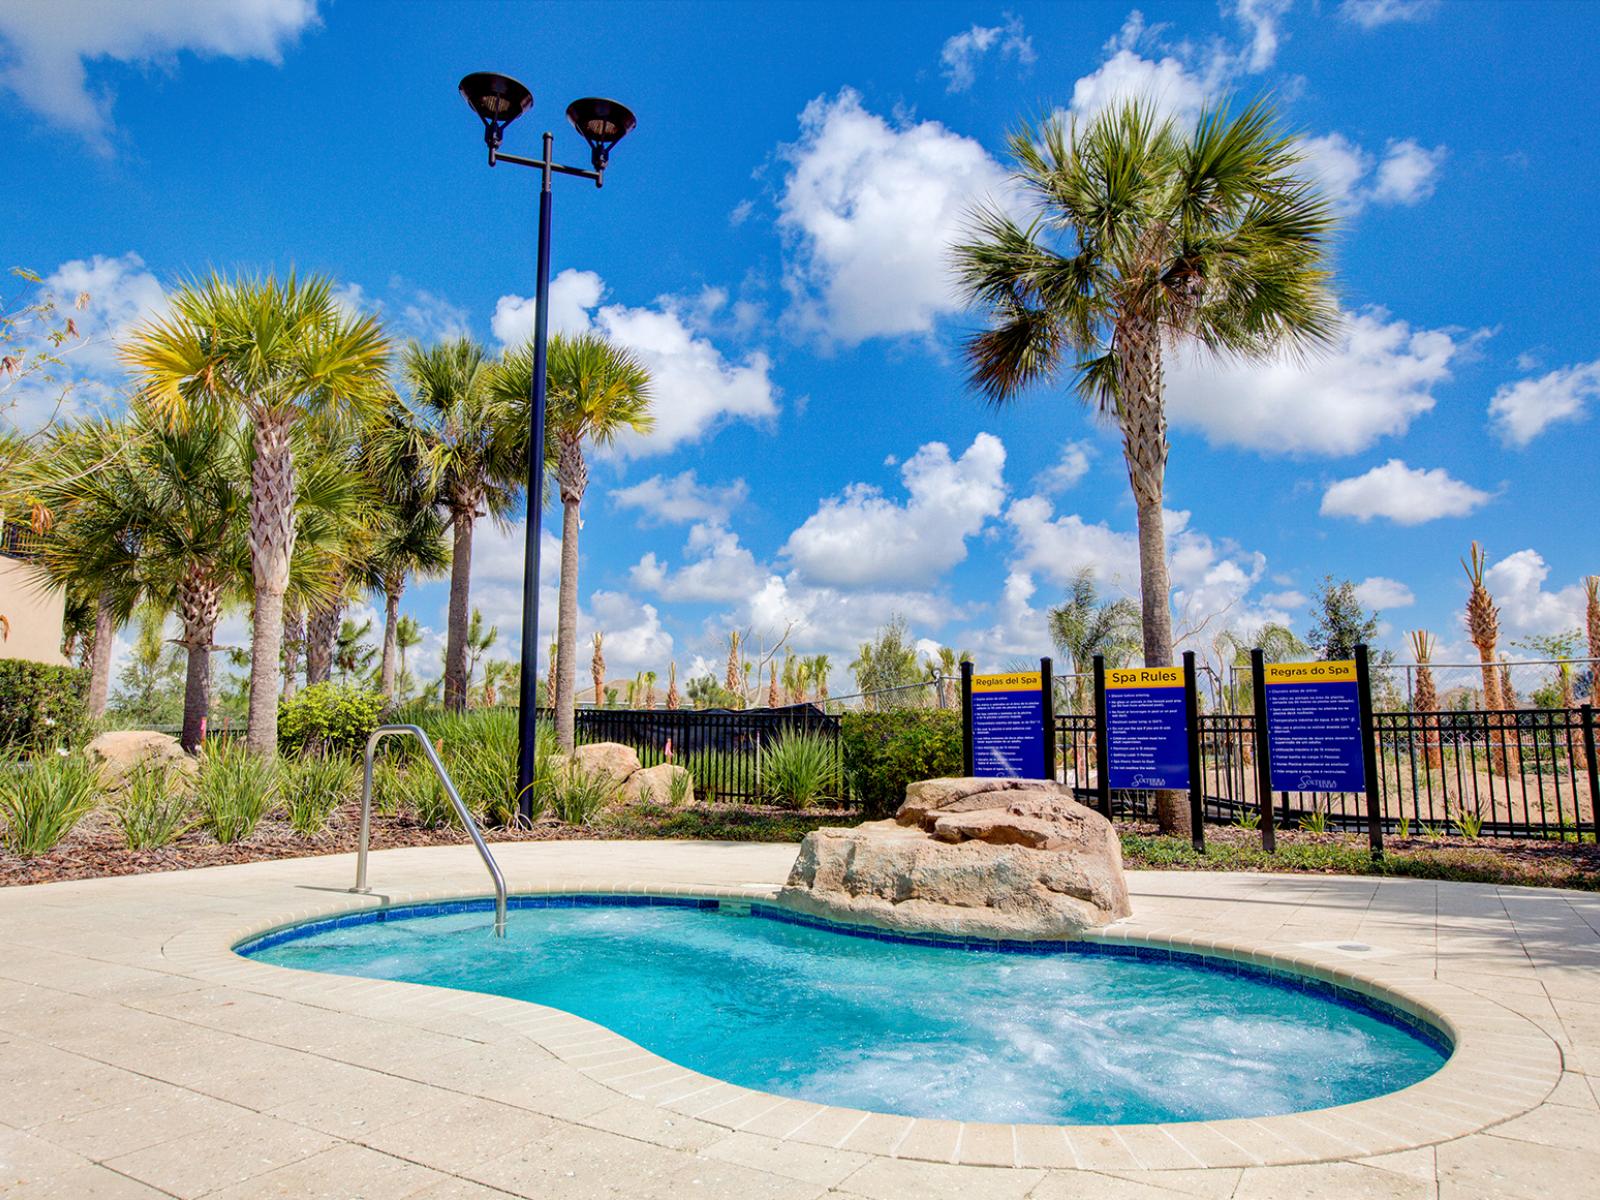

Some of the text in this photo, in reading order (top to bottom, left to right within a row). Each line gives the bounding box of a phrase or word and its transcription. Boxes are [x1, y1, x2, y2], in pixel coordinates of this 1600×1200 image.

[1271, 665, 1349, 677] Regras do Spa
[976, 676, 1037, 687] Reglas del Spa
[1112, 671, 1177, 684] Spa Rules
